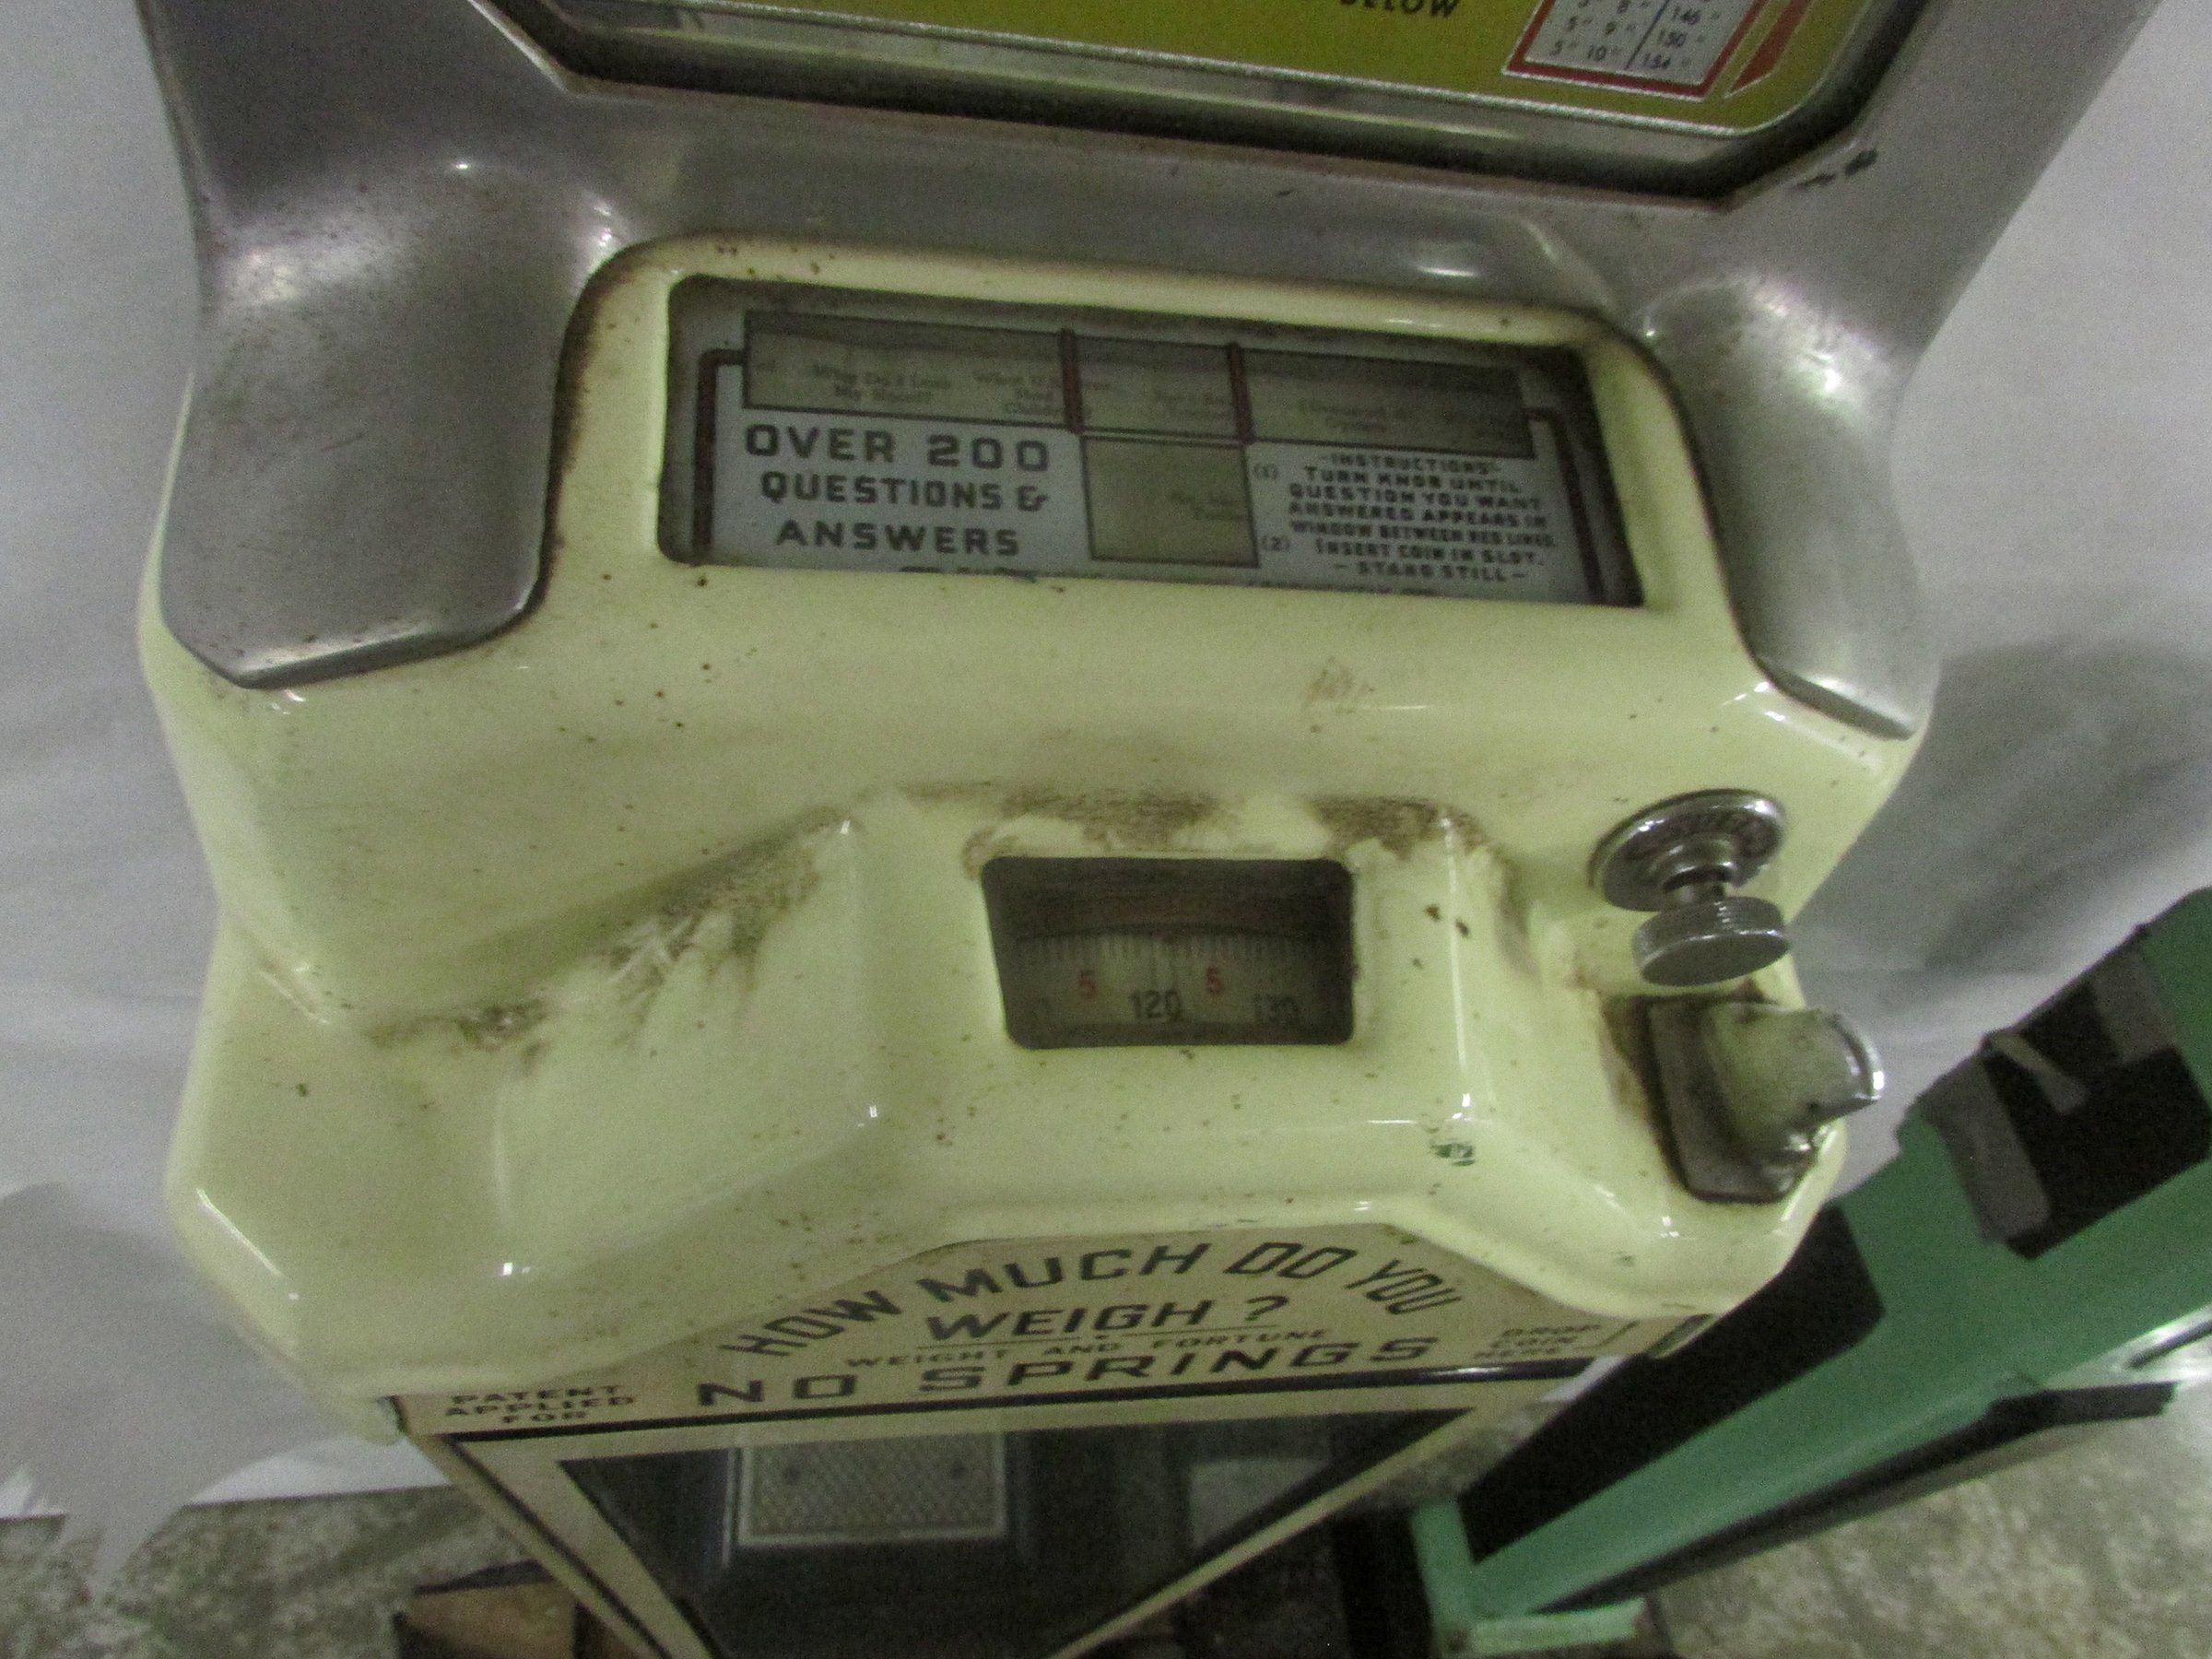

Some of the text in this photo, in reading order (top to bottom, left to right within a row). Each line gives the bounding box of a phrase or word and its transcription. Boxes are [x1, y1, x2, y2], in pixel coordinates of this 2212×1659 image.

[1586, 44, 1607, 61] 10
[745, 423, 1050, 473] OVER 200
[760, 470, 1048, 512] QUESTIONS &
[1305, 465, 1369, 484] TURN
[1378, 473, 1441, 488] KNOB
[1451, 477, 1521, 493] UNTIL
[1290, 483, 1540, 511] QUESTION YOU WANT
[1289, 502, 1547, 528] ANSWERED APPEARS IN
[776, 520, 1018, 556] ANSWERS
[1290, 520, 1372, 537] WINDOW
[1380, 525, 1464, 542] BETWEEN
[1316, 538, 1391, 558] INSERT
[1398, 544, 1445, 559] COIN
[1452, 547, 1475, 560] IN
[1359, 561, 1507, 582] STAND STILL
[1077, 965, 1225, 1000] 5 5
[1129, 988, 1182, 1021] 120
[719, 1241, 1463, 1358] HOW MUCH DO YOU
[925, 1298, 1214, 1342] WEIGH
[845, 1328, 1328, 1368] WEIGHT AND FORTUNE
[696, 1336, 1440, 1406] NO SPRINGS
[445, 1396, 635, 1417] APPLIED
[452, 1384, 619, 1405] PATENT
[502, 1411, 587, 1424] FOR
